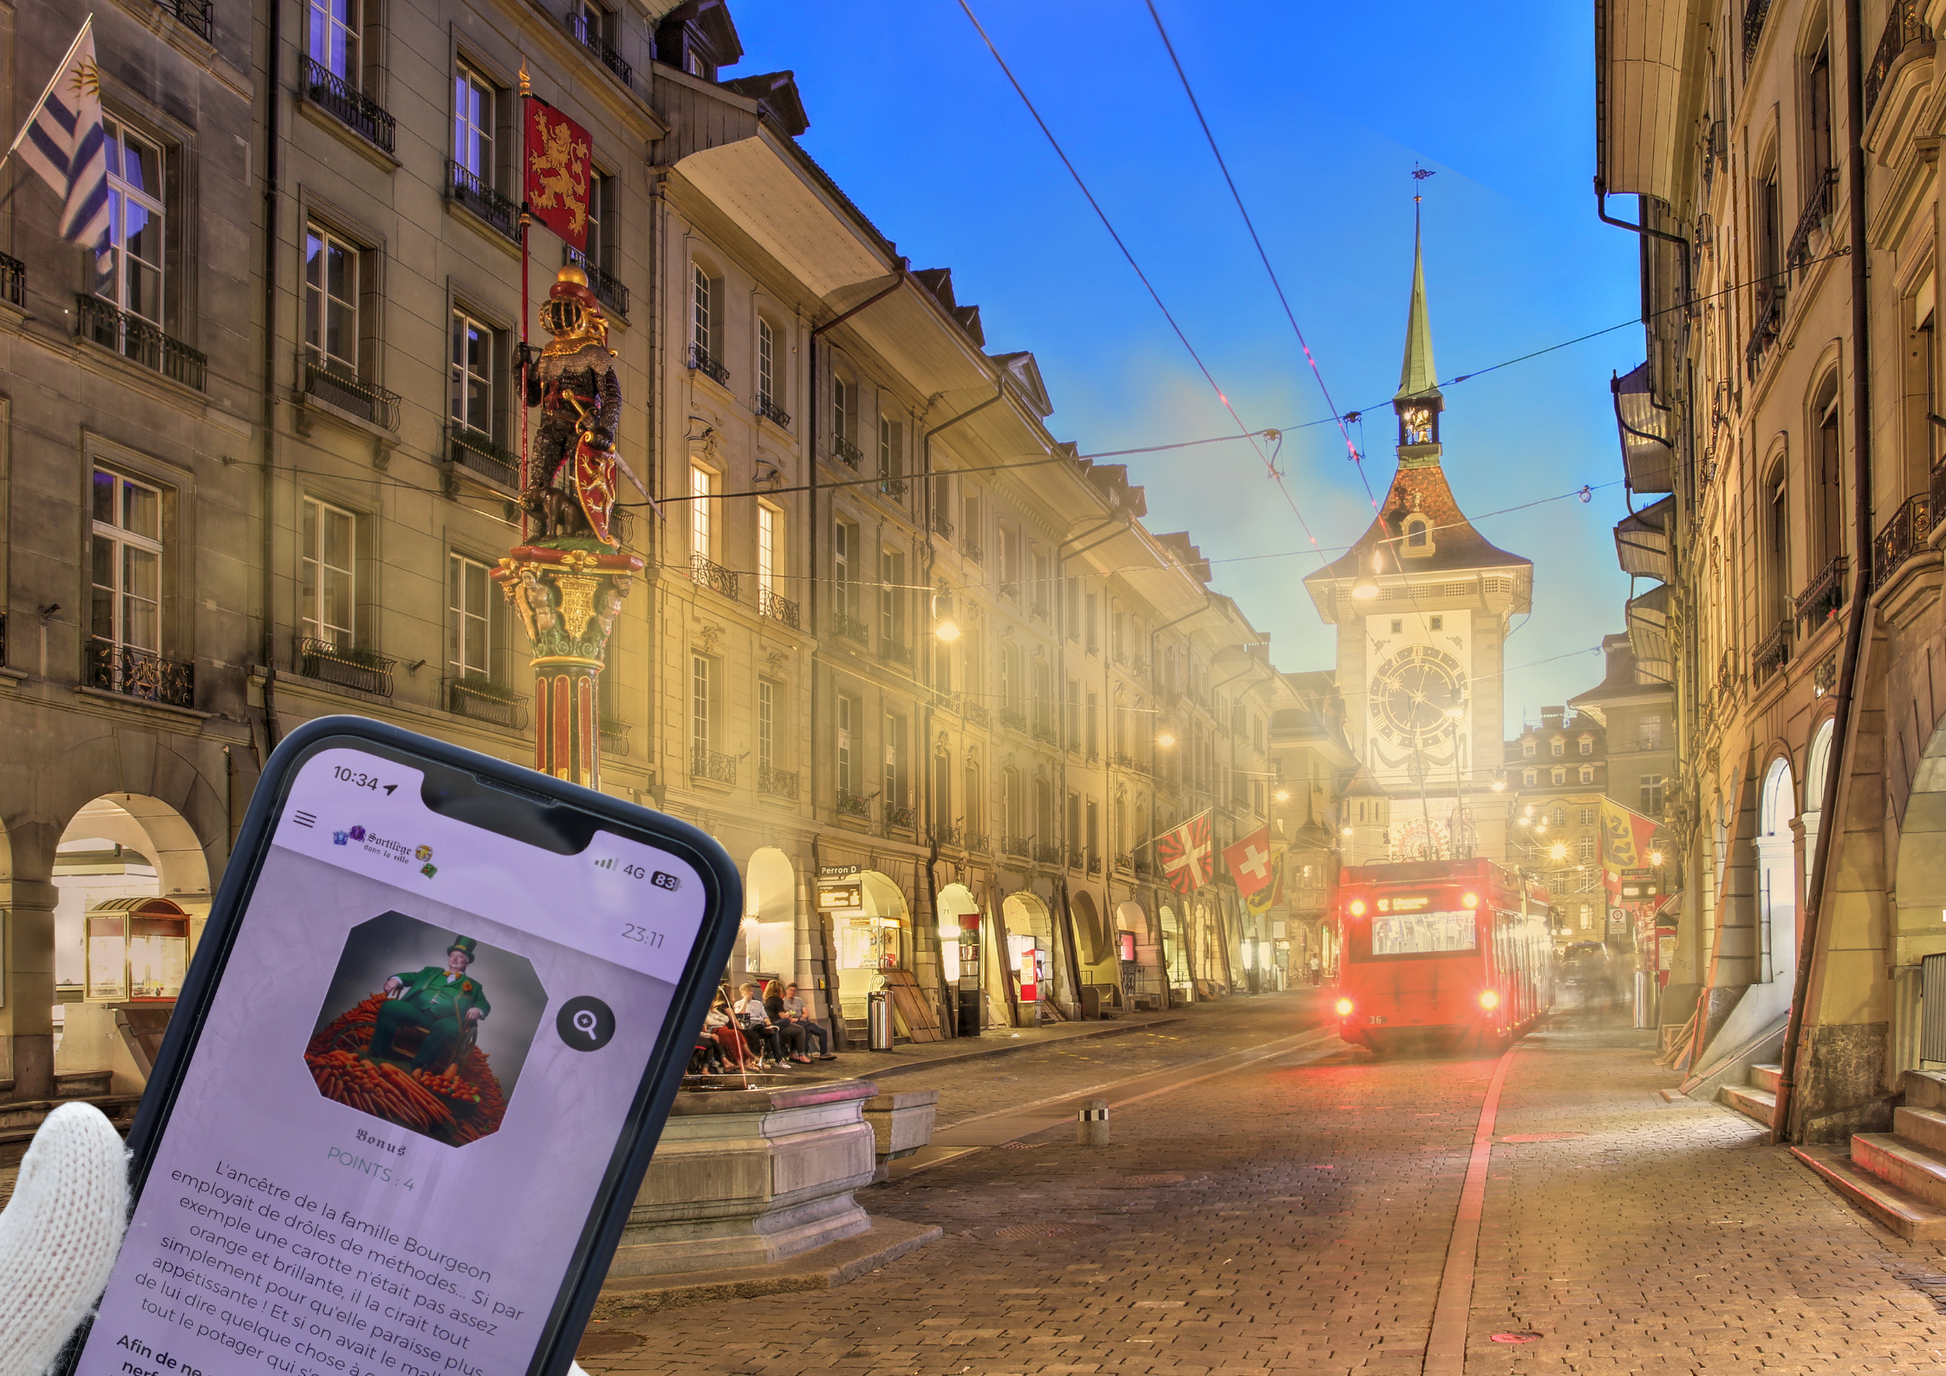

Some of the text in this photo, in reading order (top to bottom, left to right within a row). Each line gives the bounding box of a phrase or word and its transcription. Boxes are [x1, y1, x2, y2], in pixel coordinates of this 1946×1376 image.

[333, 764, 379, 792] 10:34
[363, 844, 410, 865] dans la ville
[367, 832, 412, 856] Sortilège
[622, 863, 676, 890] 4G 83
[821, 865, 857, 875] Perron D
[620, 922, 665, 950] 23:11
[1369, 1015, 1382, 1025] 36
[355, 1128, 407, 1157] Bonus
[326, 1146, 393, 1183] POINTS
[403, 1177, 415, 1192] 4
[215, 1160, 492, 1284] L'ancêtre de la famille Bourgeon
[171, 1169, 525, 1322] employait de drôles de méthodes... Si par
[179, 1196, 498, 1337] exemple une carotte n'était pas assez
[160, 1236, 484, 1376] simplement pour qu'elle paraisse plus
[189, 1225, 470, 1350] orange et brillante, il la cirait tout
[134, 1272, 360, 1376] de lui dire quelque chose à
[152, 1257, 258, 1309] appétissante
[269, 1303, 290, 1323] Et
[291, 1316, 307, 1330] si
[309, 1323, 332, 1342] on
[335, 1335, 378, 1361] avait
[379, 1349, 397, 1368] le
[116, 1334, 203, 1376] Afin de ne
[141, 1297, 177, 1323] tout
[178, 1312, 194, 1330] le
[195, 1323, 265, 1360] potager
[266, 1354, 297, 1374] qui
